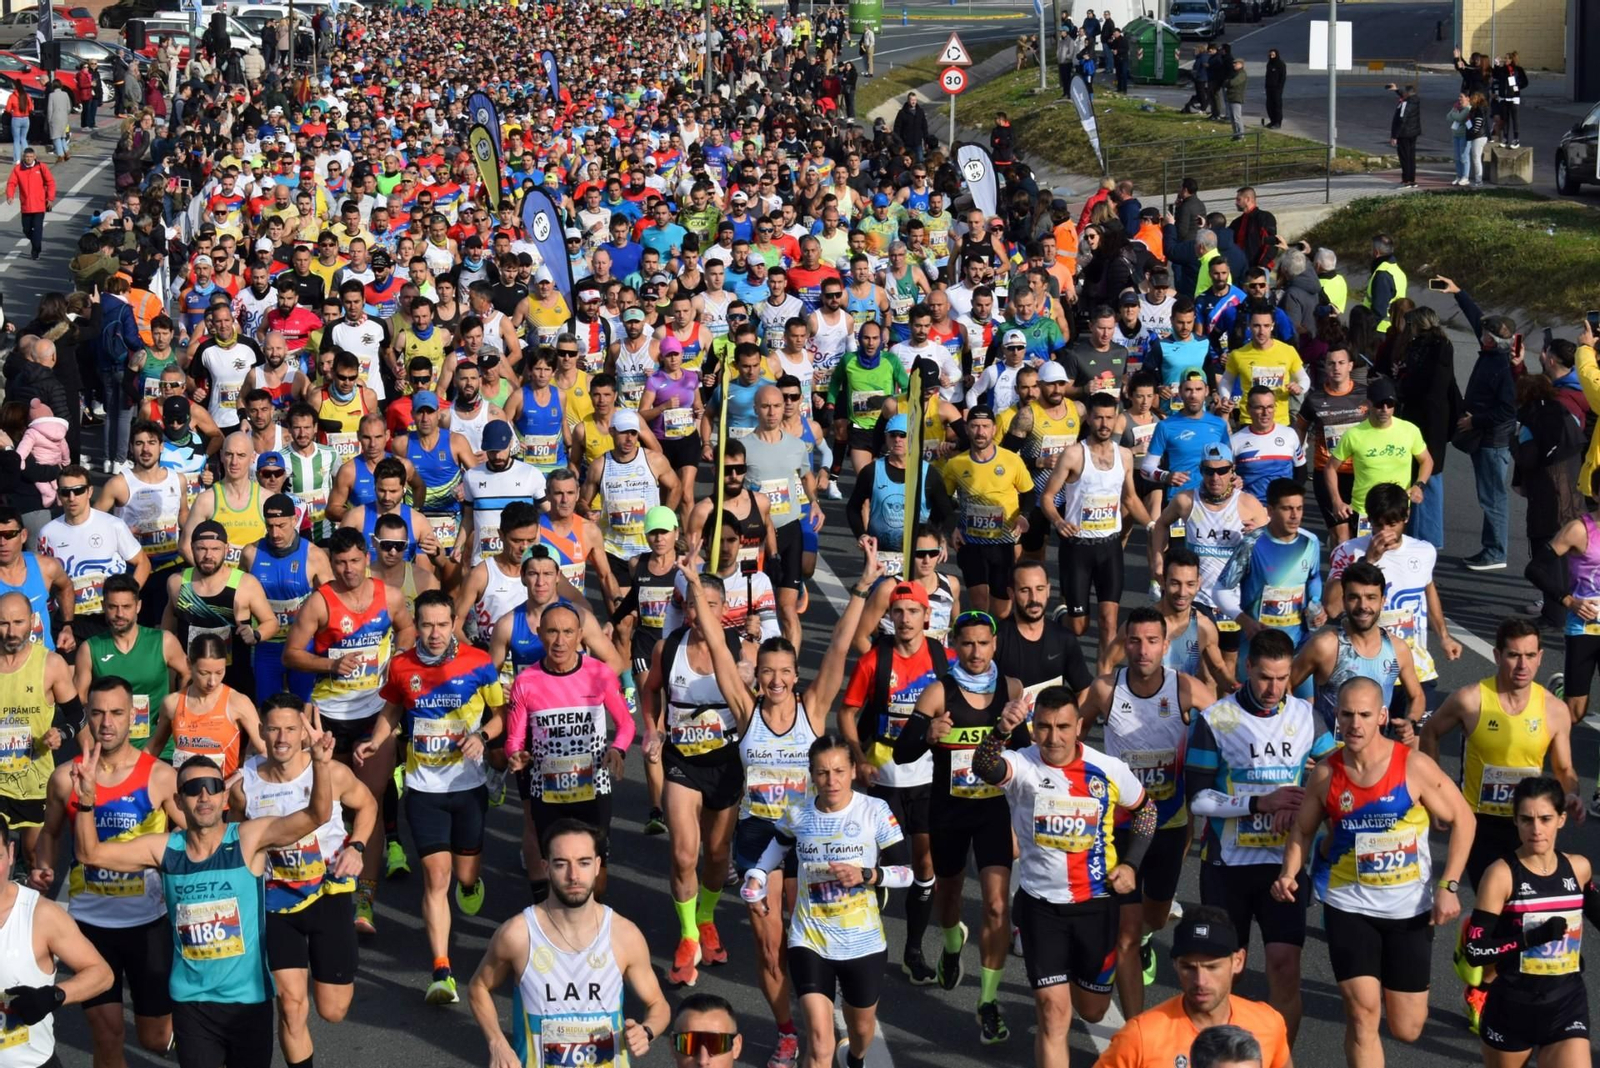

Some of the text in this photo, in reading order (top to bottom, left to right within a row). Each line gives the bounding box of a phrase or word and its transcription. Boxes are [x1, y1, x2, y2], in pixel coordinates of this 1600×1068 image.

[946, 76, 962, 85] 30
[968, 162, 978, 171] 1h
[535, 216, 544, 227] 1h
[766, 316, 787, 325] LAR
[1142, 315, 1164, 324] LAR
[623, 363, 644, 372] LAR
[1258, 376, 1279, 387] 1827
[533, 445, 550, 456] 190
[624, 480, 649, 489] Training
[621, 512, 631, 524] 17
[1088, 507, 1114, 521] 2058
[972, 516, 996, 529] 1936
[152, 530, 167, 543] 119
[1196, 527, 1231, 541] LAR
[1194, 546, 1234, 556] RUNNING
[81, 587, 96, 600] 42
[648, 601, 667, 615] 147
[1277, 600, 1293, 615] 911
[341, 637, 383, 649] PALACIEGO
[415, 698, 462, 709] PALACIEGO
[3, 706, 41, 716] PIRÁMIDE
[0, 716, 30, 725] FLORES
[536, 711, 592, 728] ENTRENA
[542, 723, 596, 740] Y MEJORA
[678, 726, 715, 743] 2086
[426, 736, 450, 752] 102
[1250, 742, 1292, 759] LAR
[746, 749, 773, 758] Falcón
[1246, 769, 1294, 780] RUNNING
[555, 772, 579, 791] 188
[768, 785, 785, 802] 19
[1049, 799, 1055, 807] 45
[1044, 816, 1086, 837] 1099
[1341, 817, 1398, 830] PALACIEGO
[824, 842, 864, 857] Training
[280, 851, 303, 867] 157
[1373, 851, 1406, 872] 529
[189, 921, 227, 944] 1186
[545, 982, 602, 1003] LAR
[557, 1026, 565, 1034] 45
[565, 1026, 584, 1034] MEDIA
[560, 1044, 598, 1065] 768
